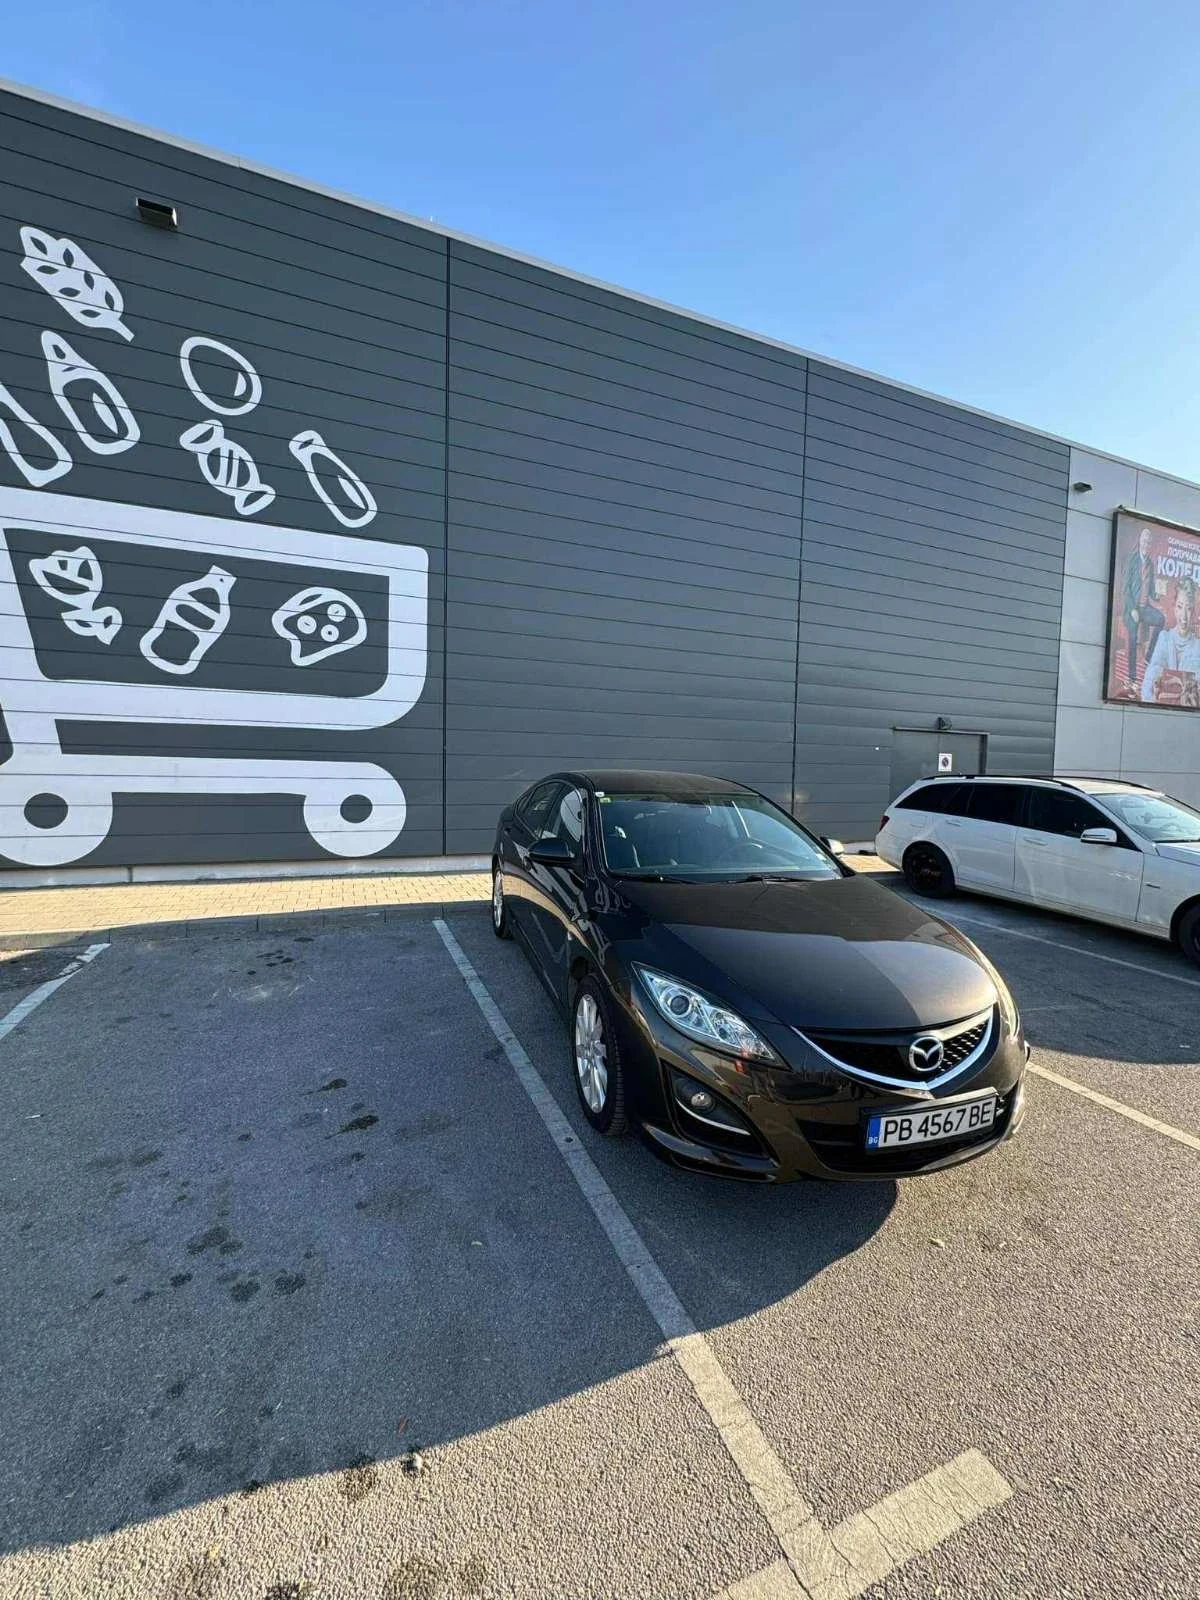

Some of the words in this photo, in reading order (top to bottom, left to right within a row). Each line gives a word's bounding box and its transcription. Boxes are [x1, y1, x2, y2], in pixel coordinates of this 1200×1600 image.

[884, 1118, 912, 1143] PB
[917, 1109, 966, 1138] 4567
[969, 1102, 992, 1128] BE
[868, 1136, 878, 1144] BG
